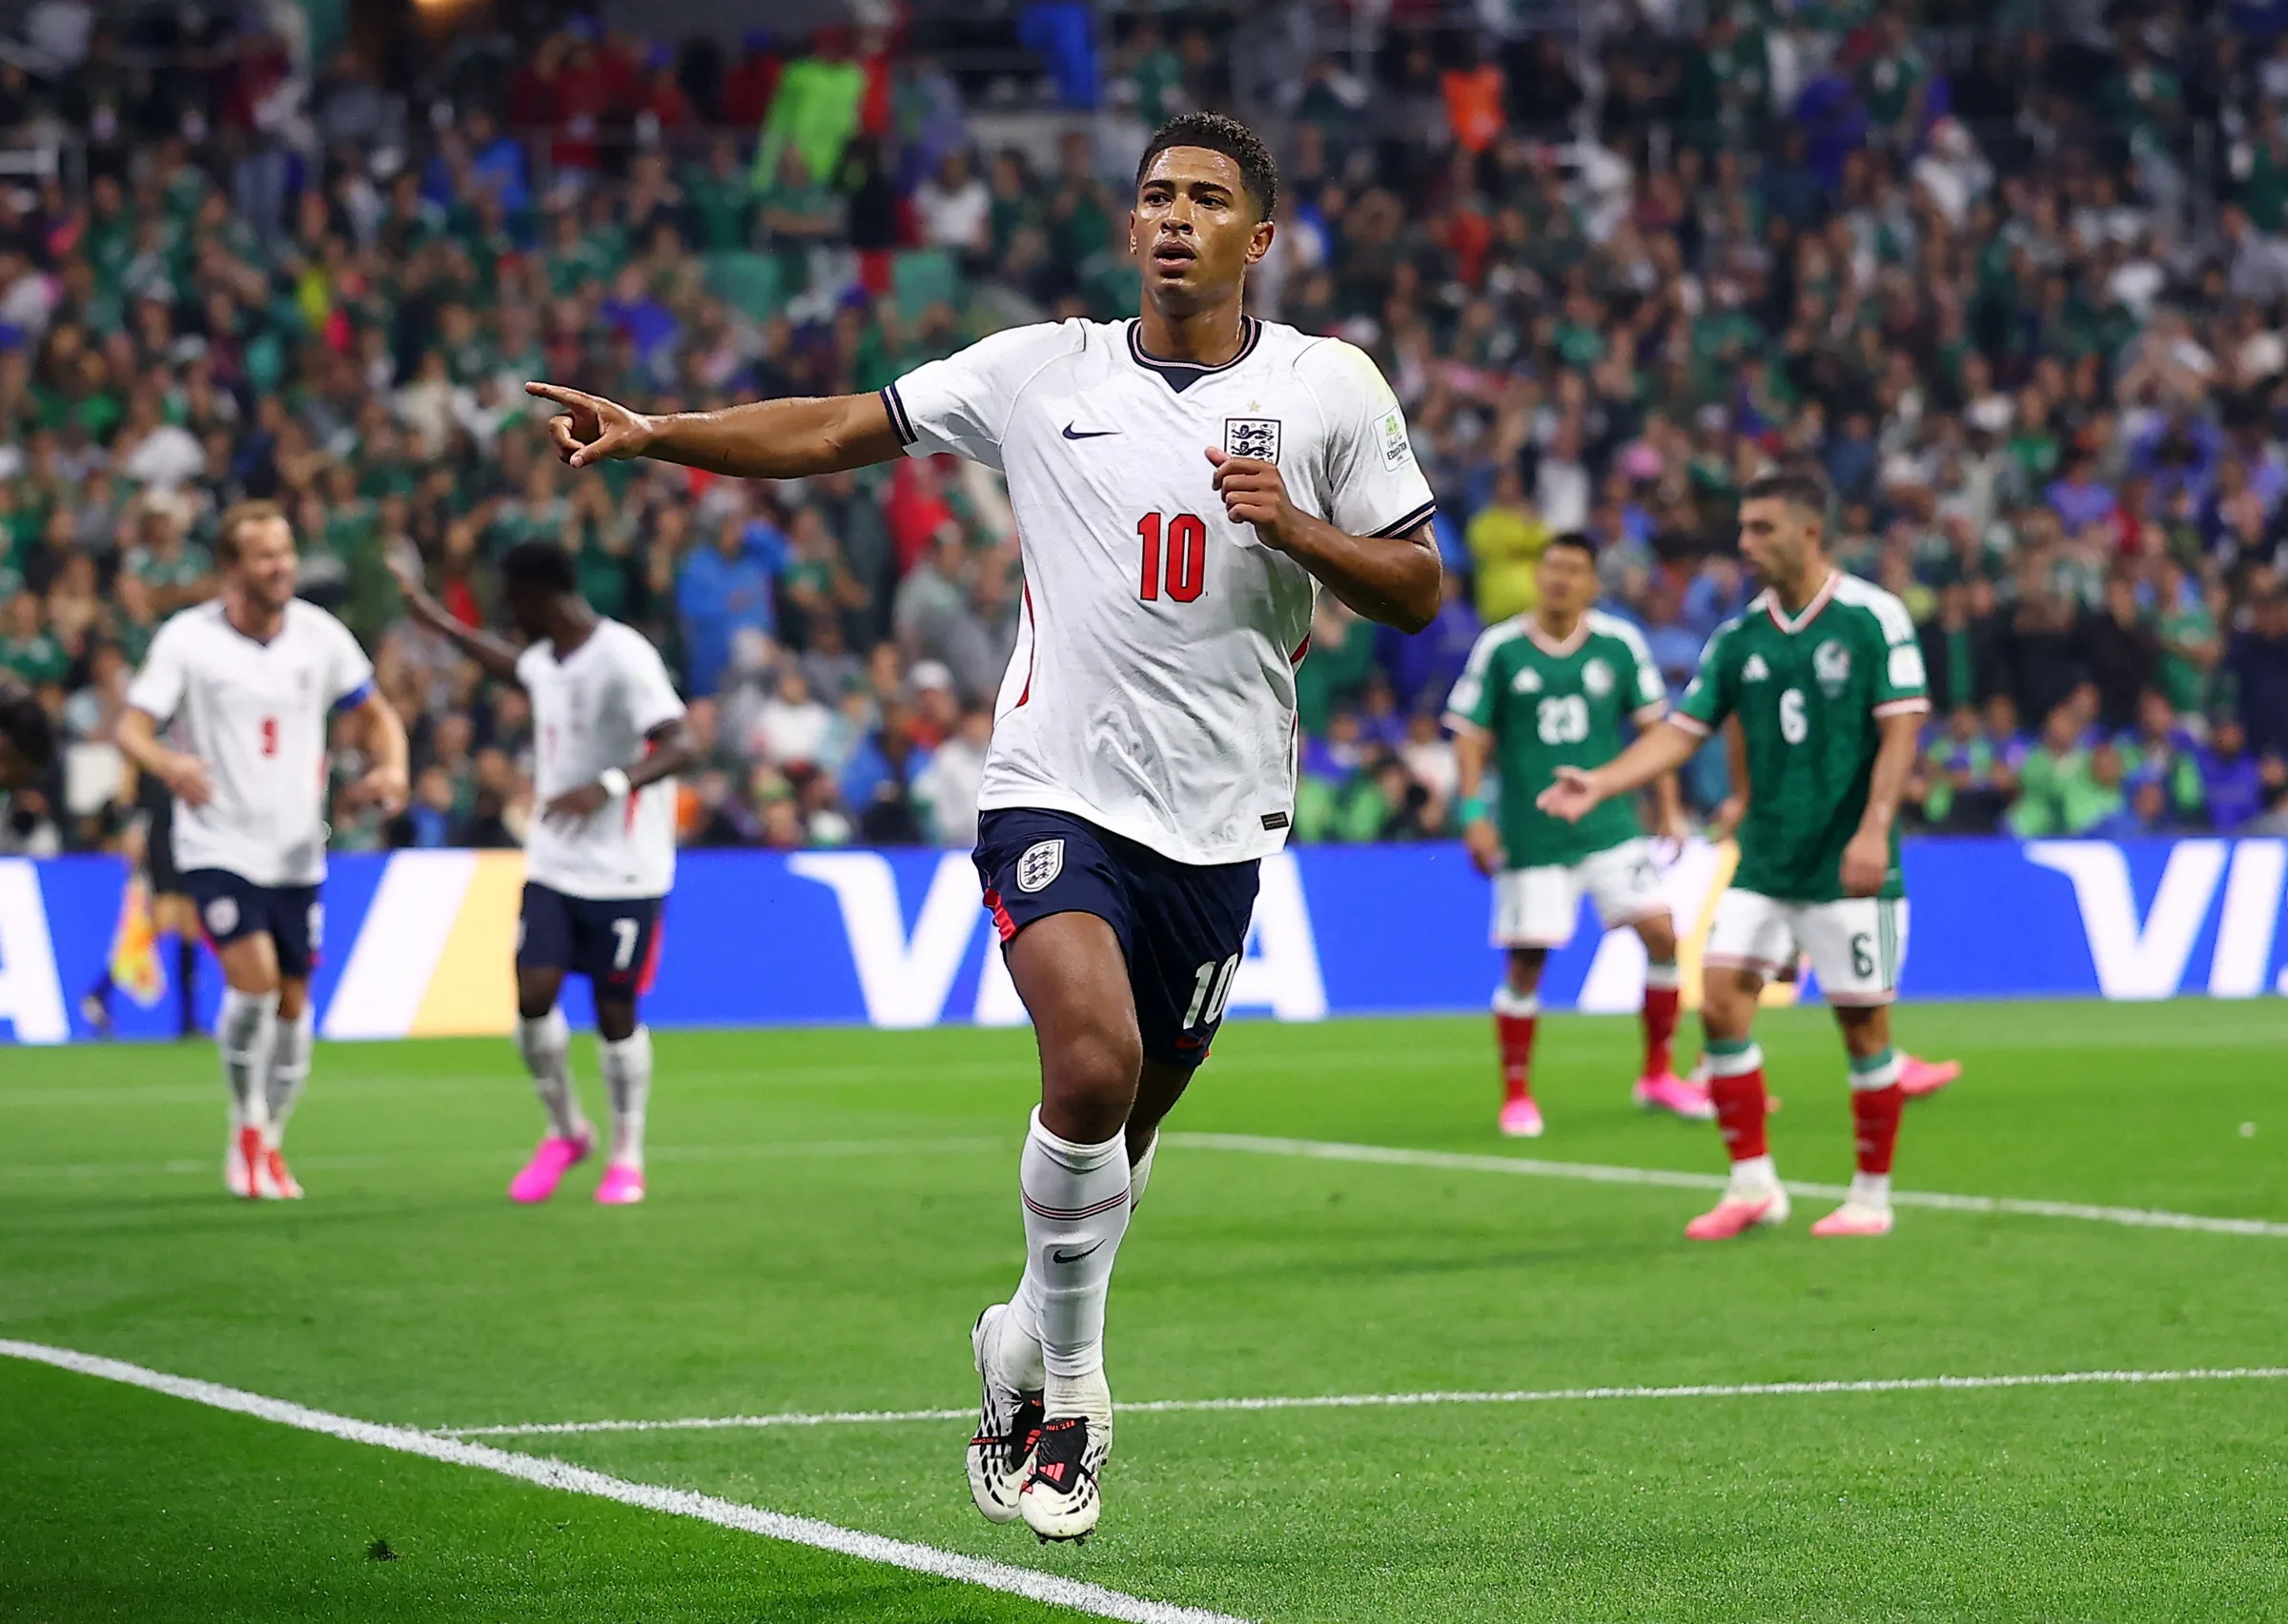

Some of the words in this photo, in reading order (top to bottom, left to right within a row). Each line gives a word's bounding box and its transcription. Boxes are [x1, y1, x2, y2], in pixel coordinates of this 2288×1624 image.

[1136, 512, 1206, 603] 10
[1779, 687, 1808, 745] 6
[1851, 933, 1874, 979] 6
[2022, 838, 2288, 1001] VI
[1183, 952, 1238, 1030] 10
